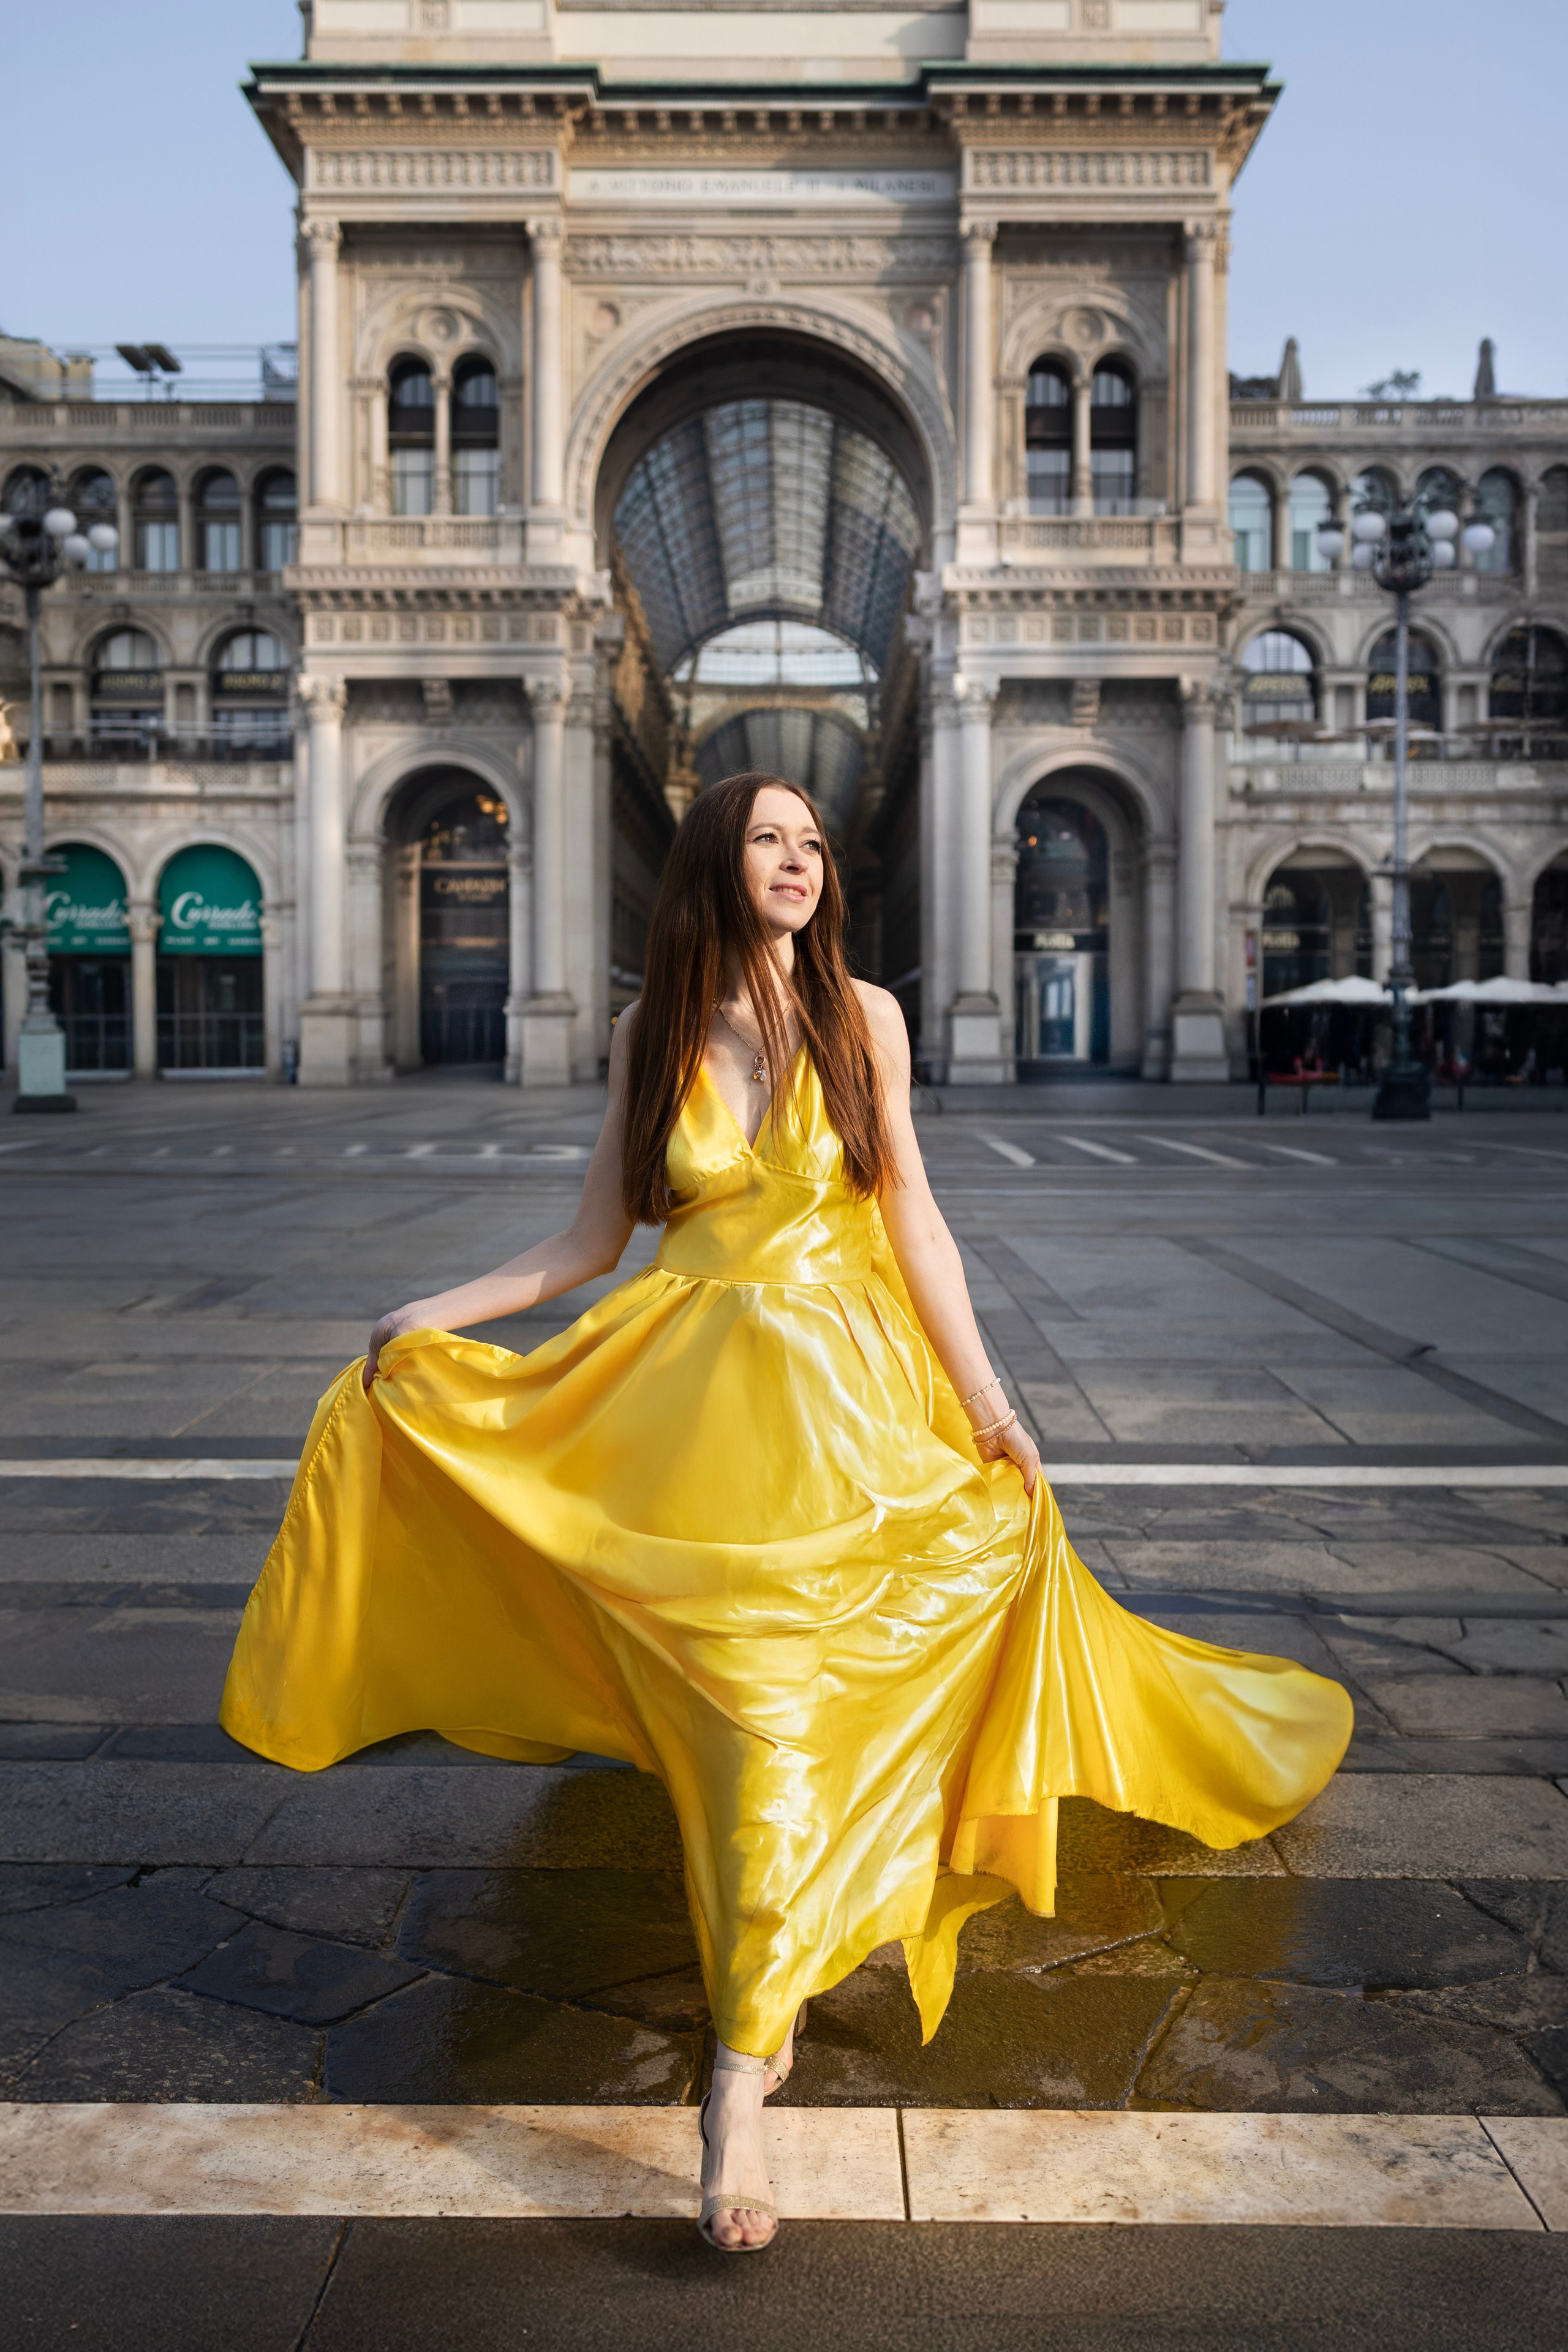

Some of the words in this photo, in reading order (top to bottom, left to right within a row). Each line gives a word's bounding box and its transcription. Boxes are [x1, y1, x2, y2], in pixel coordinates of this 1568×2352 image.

[610, 178, 693, 193] VITTORIO
[700, 178, 796, 193] EMANUELE
[854, 178, 936, 193] MILANESI
